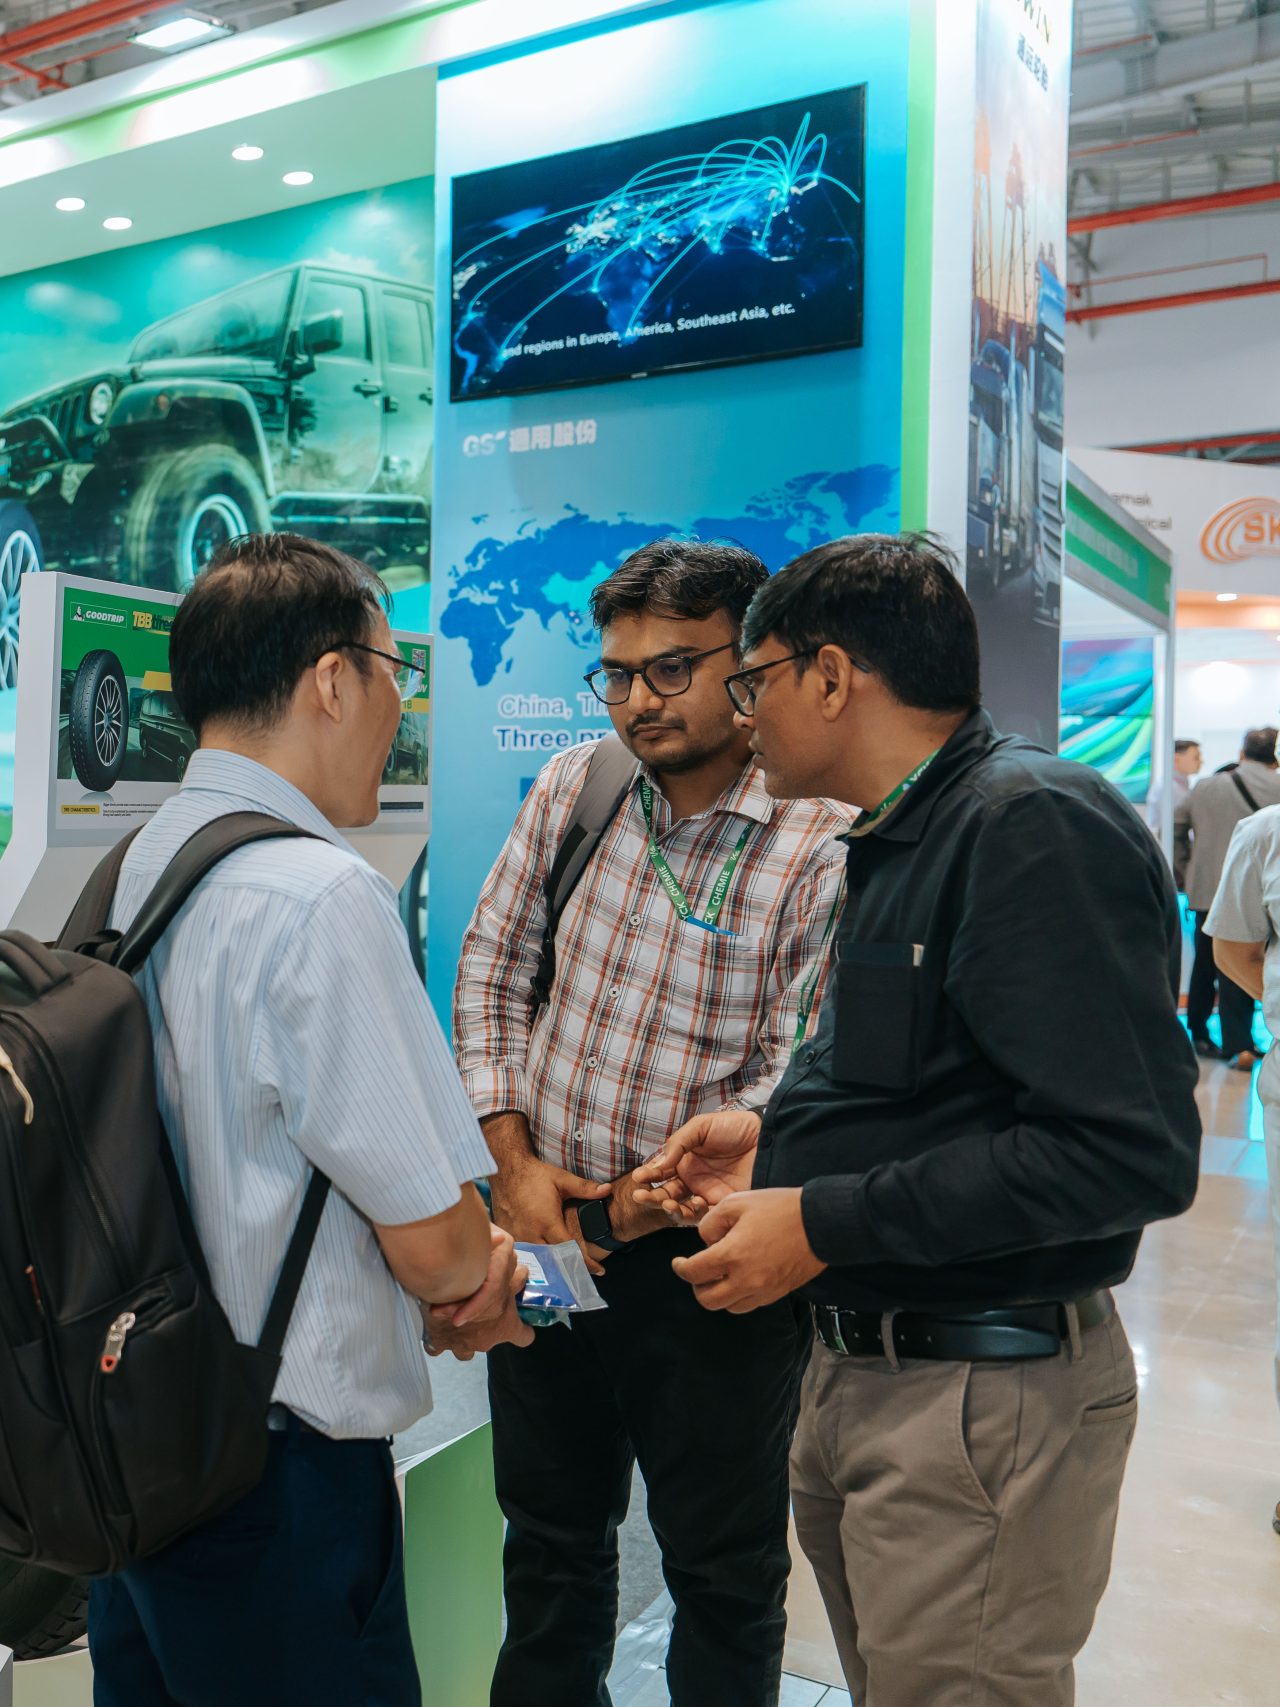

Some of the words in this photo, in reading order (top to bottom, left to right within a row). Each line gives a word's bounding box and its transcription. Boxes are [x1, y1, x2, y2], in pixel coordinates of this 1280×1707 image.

[502, 345, 522, 358] and
[524, 337, 565, 357] regions
[566, 335, 578, 348] in
[579, 330, 622, 347] Europe,
[624, 322, 675, 339] America,
[676, 311, 738, 331] Southeast
[739, 305, 770, 321] Asia,
[771, 302, 796, 317] etc.
[85, 610, 125, 624] GOODTRIP
[499, 695, 572, 719] China,
[495, 727, 571, 750] Three
[659, 865, 680, 897] CHEMIE
[712, 870, 730, 906] CHEMIE
